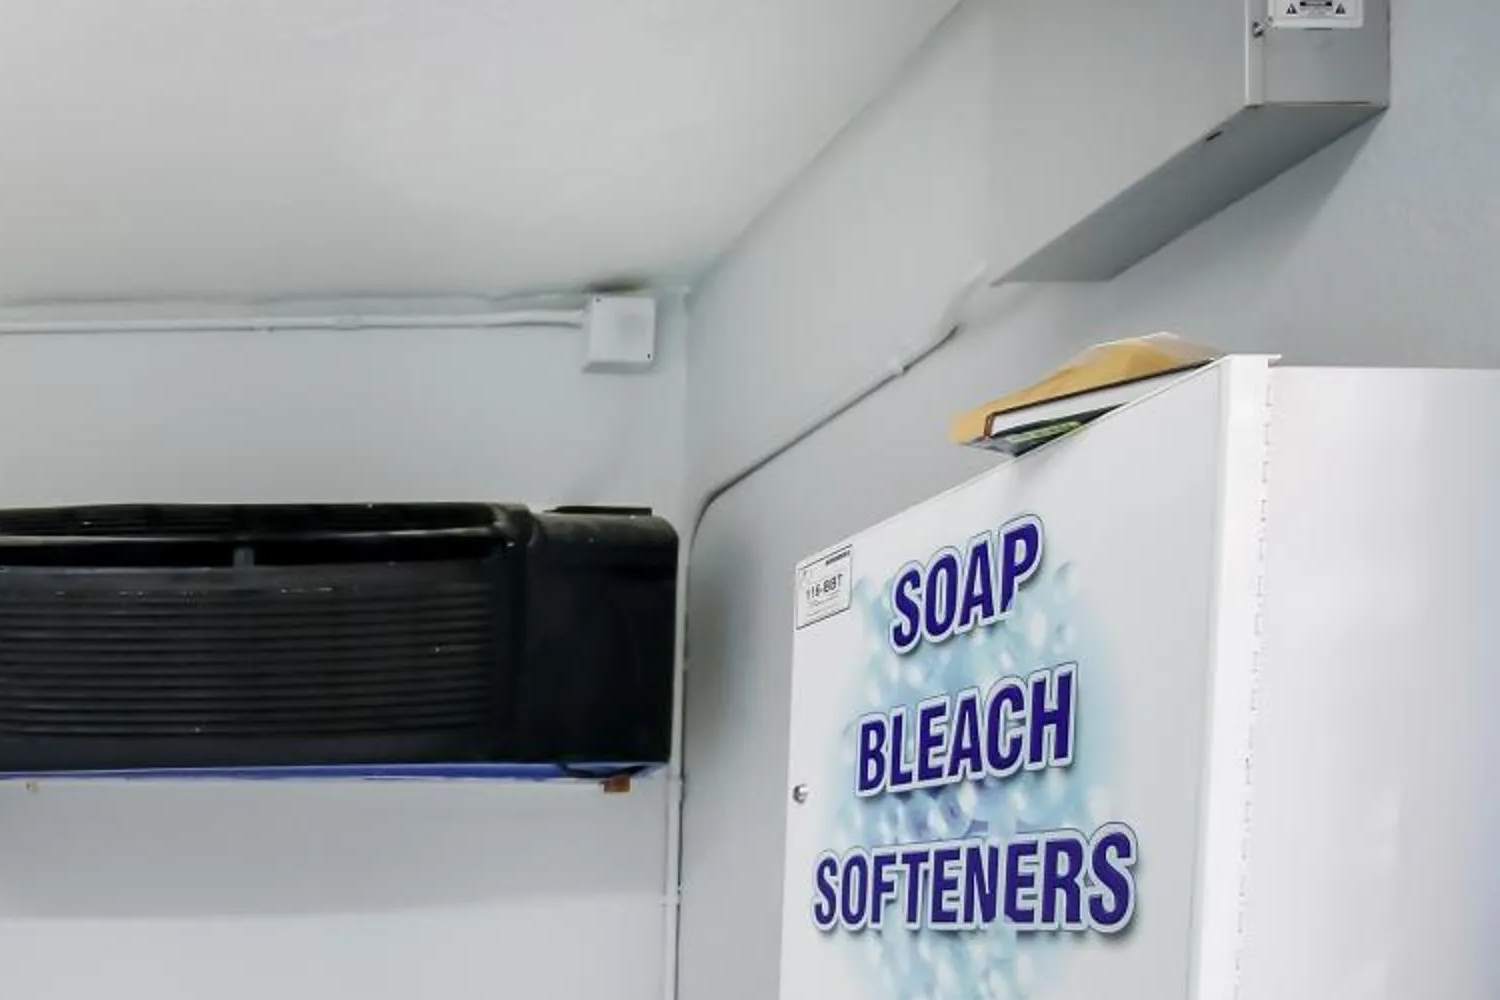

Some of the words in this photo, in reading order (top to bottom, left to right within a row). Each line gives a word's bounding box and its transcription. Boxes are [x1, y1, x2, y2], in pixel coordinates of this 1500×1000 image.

[892, 522, 1040, 648] SOAP
[857, 670, 1074, 792] BLEACH
[813, 829, 1133, 928] SOFTENERS
